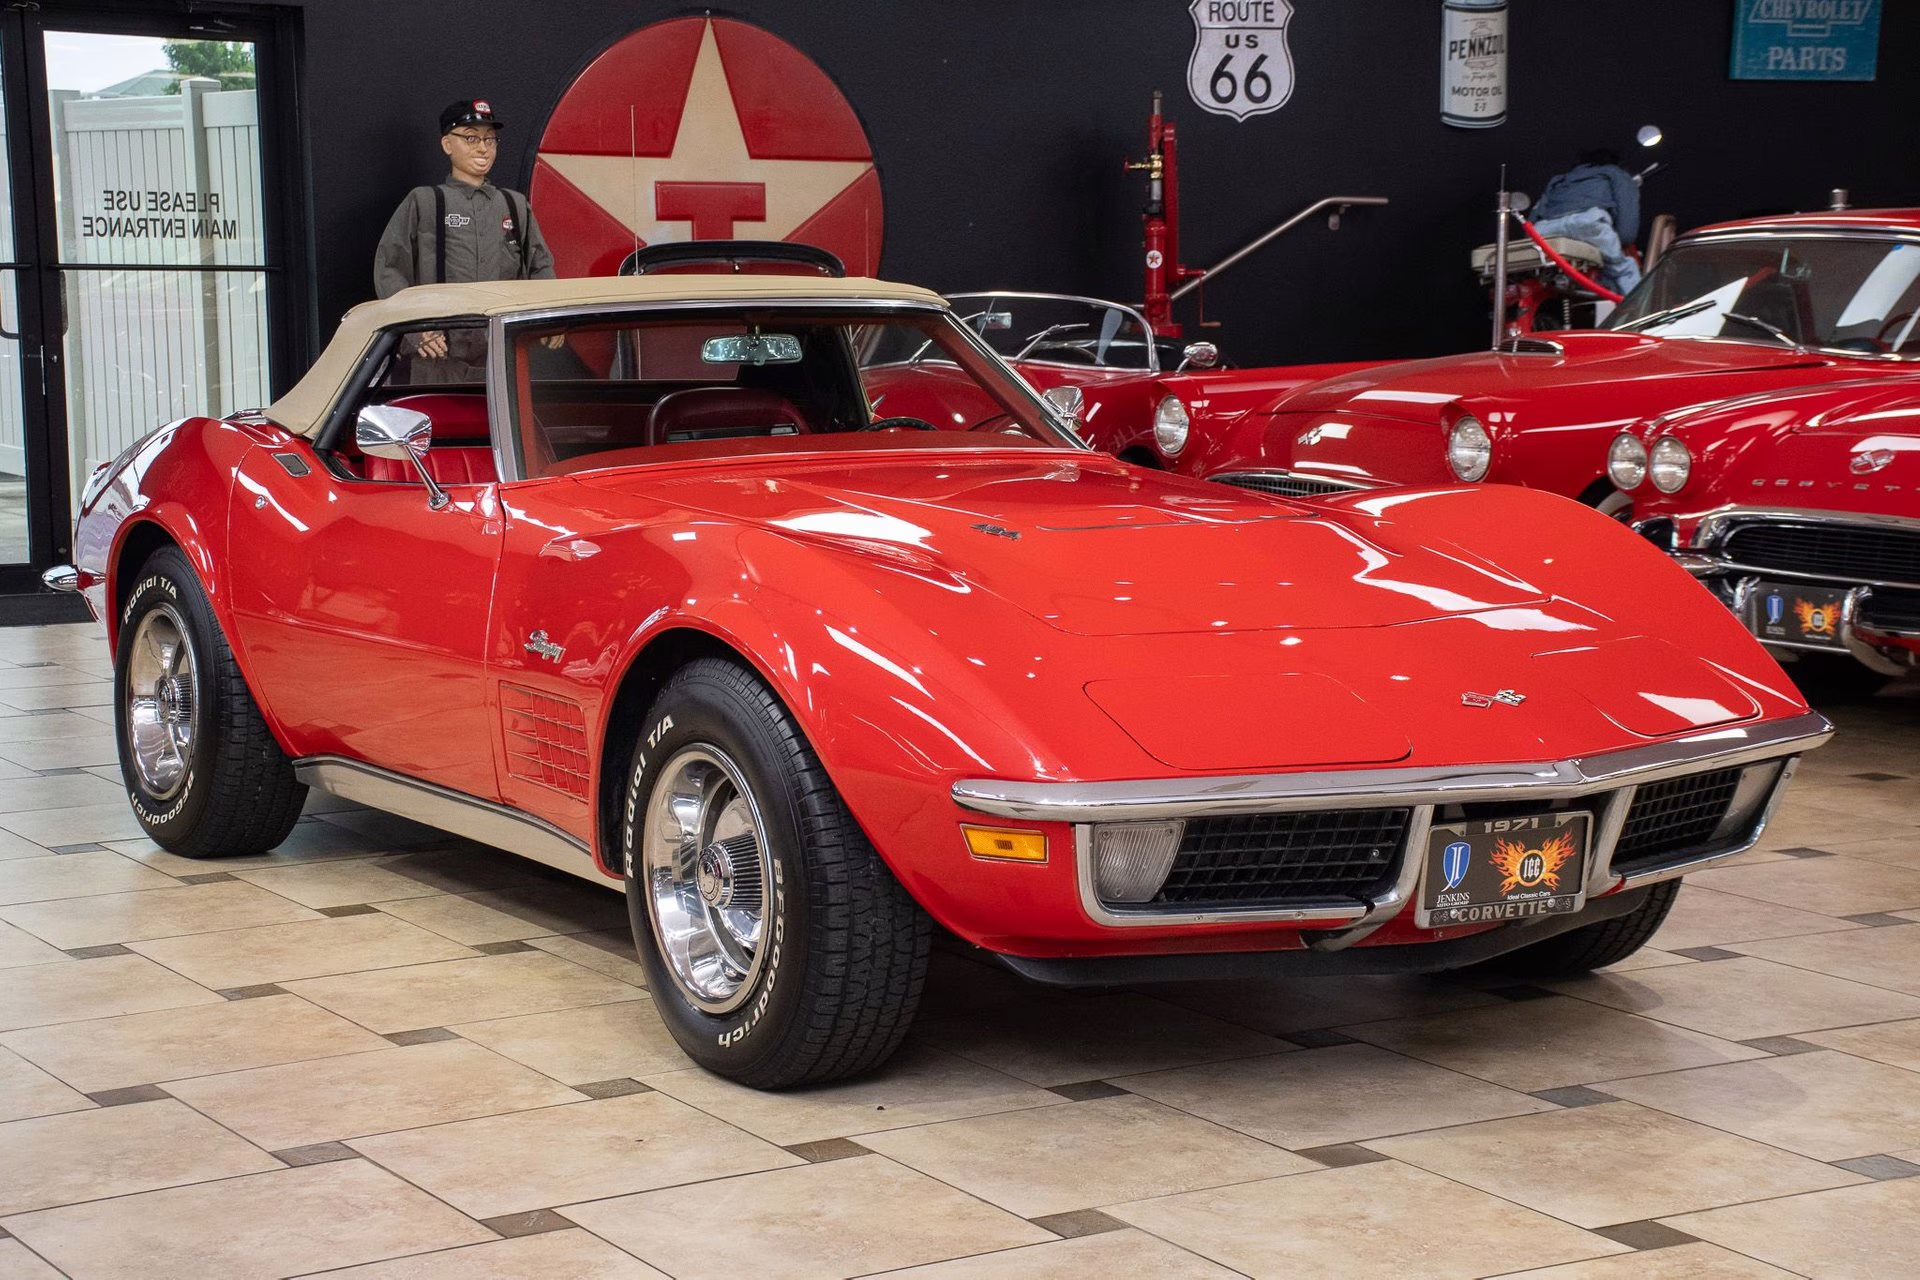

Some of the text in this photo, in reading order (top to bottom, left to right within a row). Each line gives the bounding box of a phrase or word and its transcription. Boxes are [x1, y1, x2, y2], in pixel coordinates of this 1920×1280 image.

[1208, 1, 1275, 22] ROUTE
[1760, 0, 1866, 19] CHEVROLET
[1766, 46, 1847, 71] PARTS
[1209, 53, 1272, 104] 66
[1451, 86, 1490, 97] MOTOR
[124, 575, 157, 625] Radial
[624, 714, 675, 879] Radial T/A
[1484, 818, 1540, 834] 1971
[1436, 891, 1471, 905] JENKINS
[1520, 891, 1538, 899] Classic
[1538, 890, 1551, 898] Cars
[1458, 899, 1548, 922] CORVETTE
[718, 858, 787, 1049] BFGoodrich
